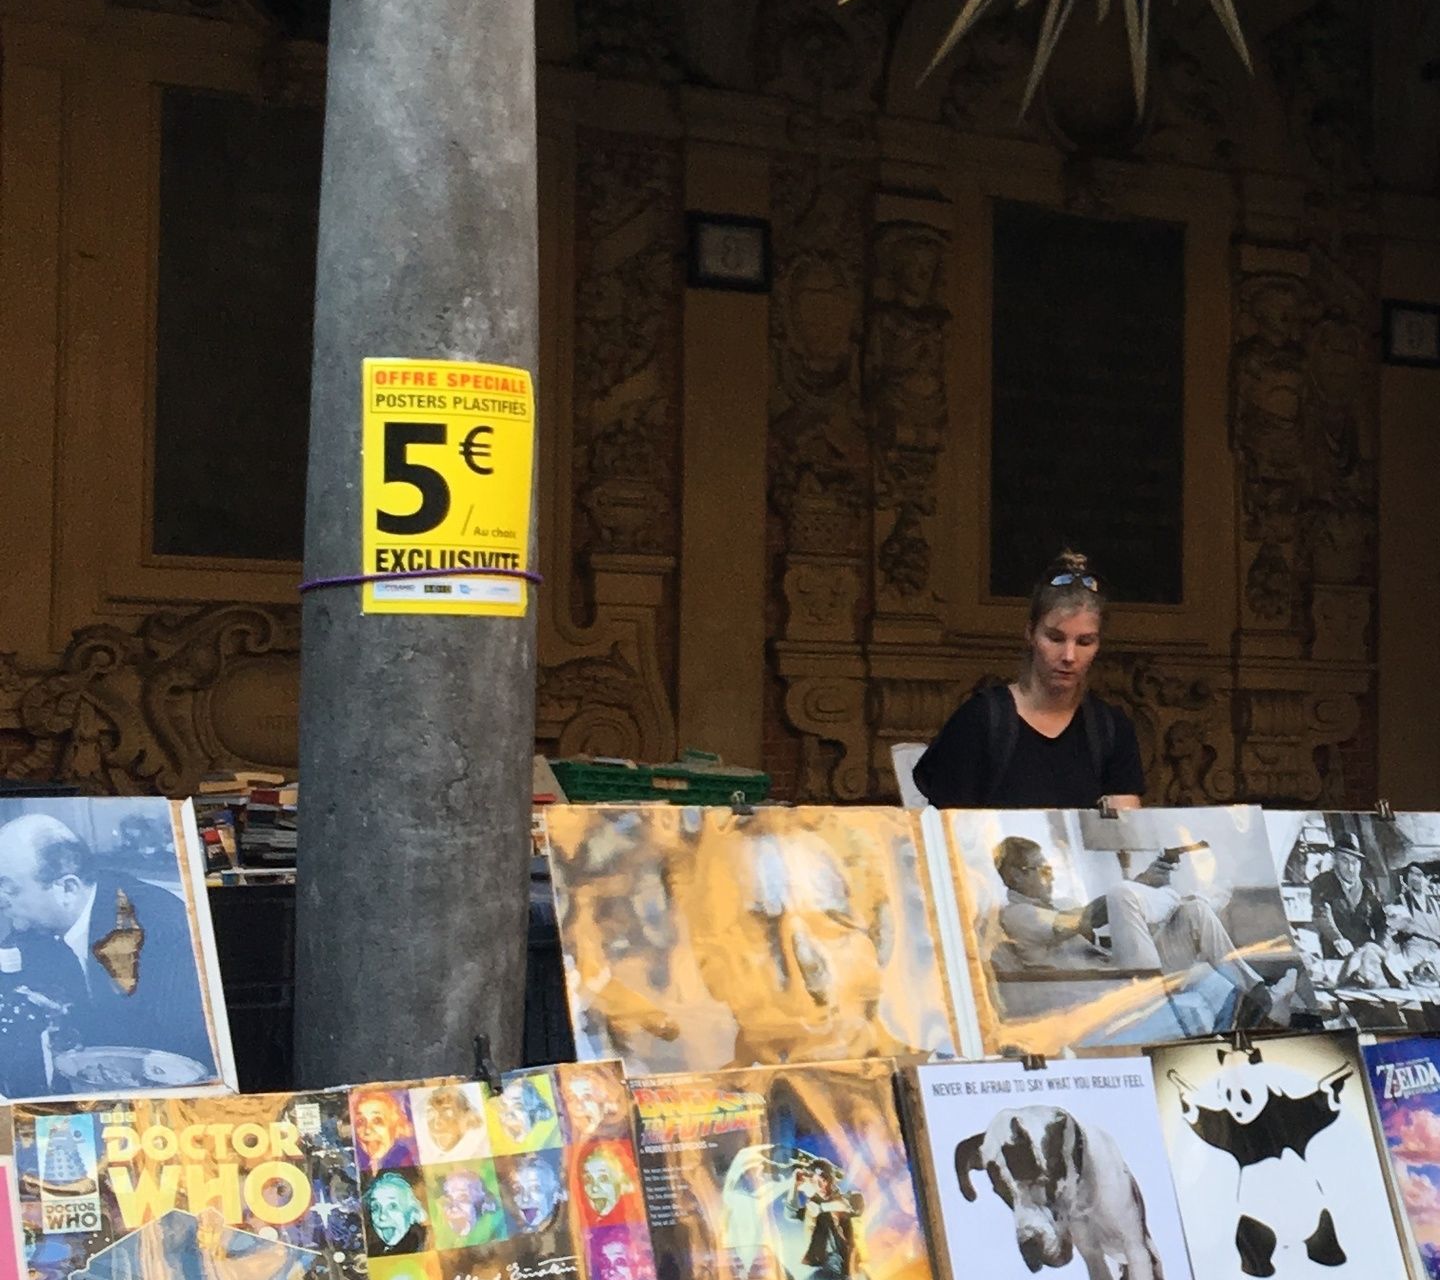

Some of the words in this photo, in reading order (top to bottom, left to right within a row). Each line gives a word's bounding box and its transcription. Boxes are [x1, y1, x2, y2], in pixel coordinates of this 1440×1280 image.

[375, 370, 437, 386] OFFRE
[447, 372, 527, 394] SPECIALE
[375, 393, 447, 409] POSTERS
[376, 421, 451, 535] 5
[375, 548, 521, 573] EXCLUSIVITE
[932, 1081, 963, 1097] NEVER
[966, 1081, 978, 1095] BE
[980, 1080, 1012, 1095] AFRAID
[1014, 1078, 1026, 1092] TO
[1028, 1078, 1044, 1092] SAY
[1047, 1076, 1071, 1091] WHAT
[1074, 1075, 1090, 1090] YOU
[1092, 1074, 1122, 1089] REALLY
[1124, 1073, 1145, 1088] FEEL
[102, 1121, 304, 1163] DOCTOR
[107, 1160, 312, 1229] WHO
[45, 1202, 96, 1215] DOCTOR
[46, 1212, 98, 1229] WHO
